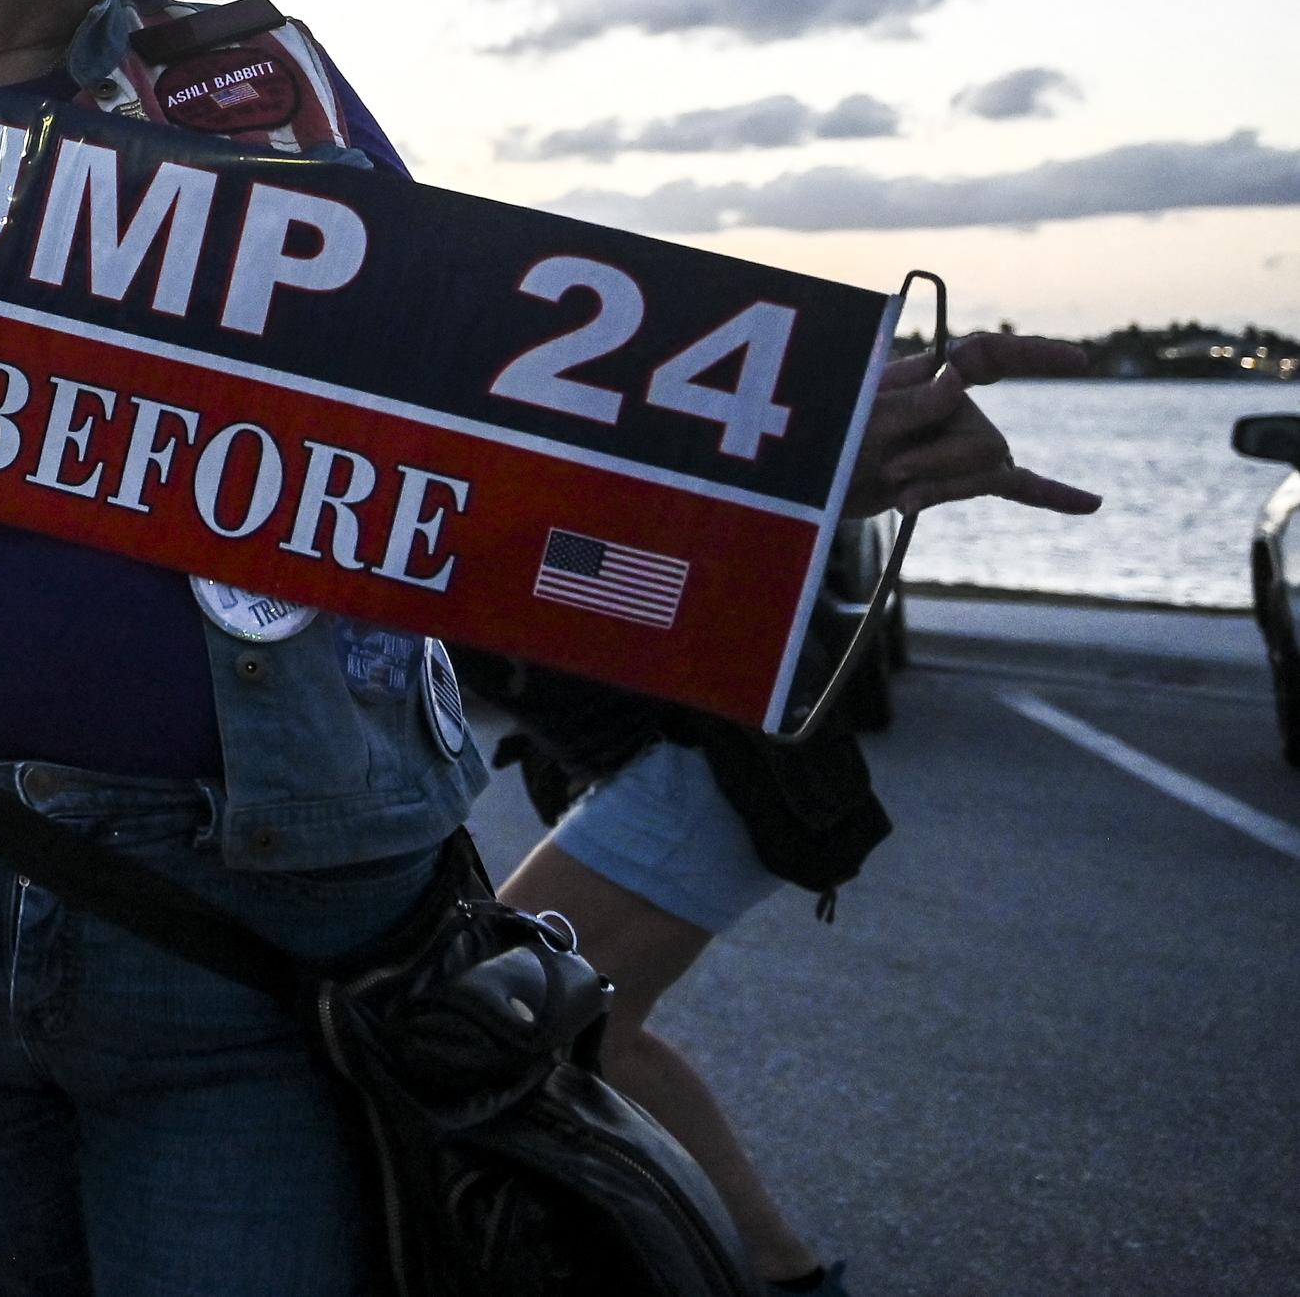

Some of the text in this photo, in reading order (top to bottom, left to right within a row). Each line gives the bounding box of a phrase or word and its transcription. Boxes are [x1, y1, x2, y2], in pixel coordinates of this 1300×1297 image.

[167, 61, 274, 108] ASHLI BABBITT
[488, 255, 797, 460] 24
[248, 598, 302, 628] TRU
